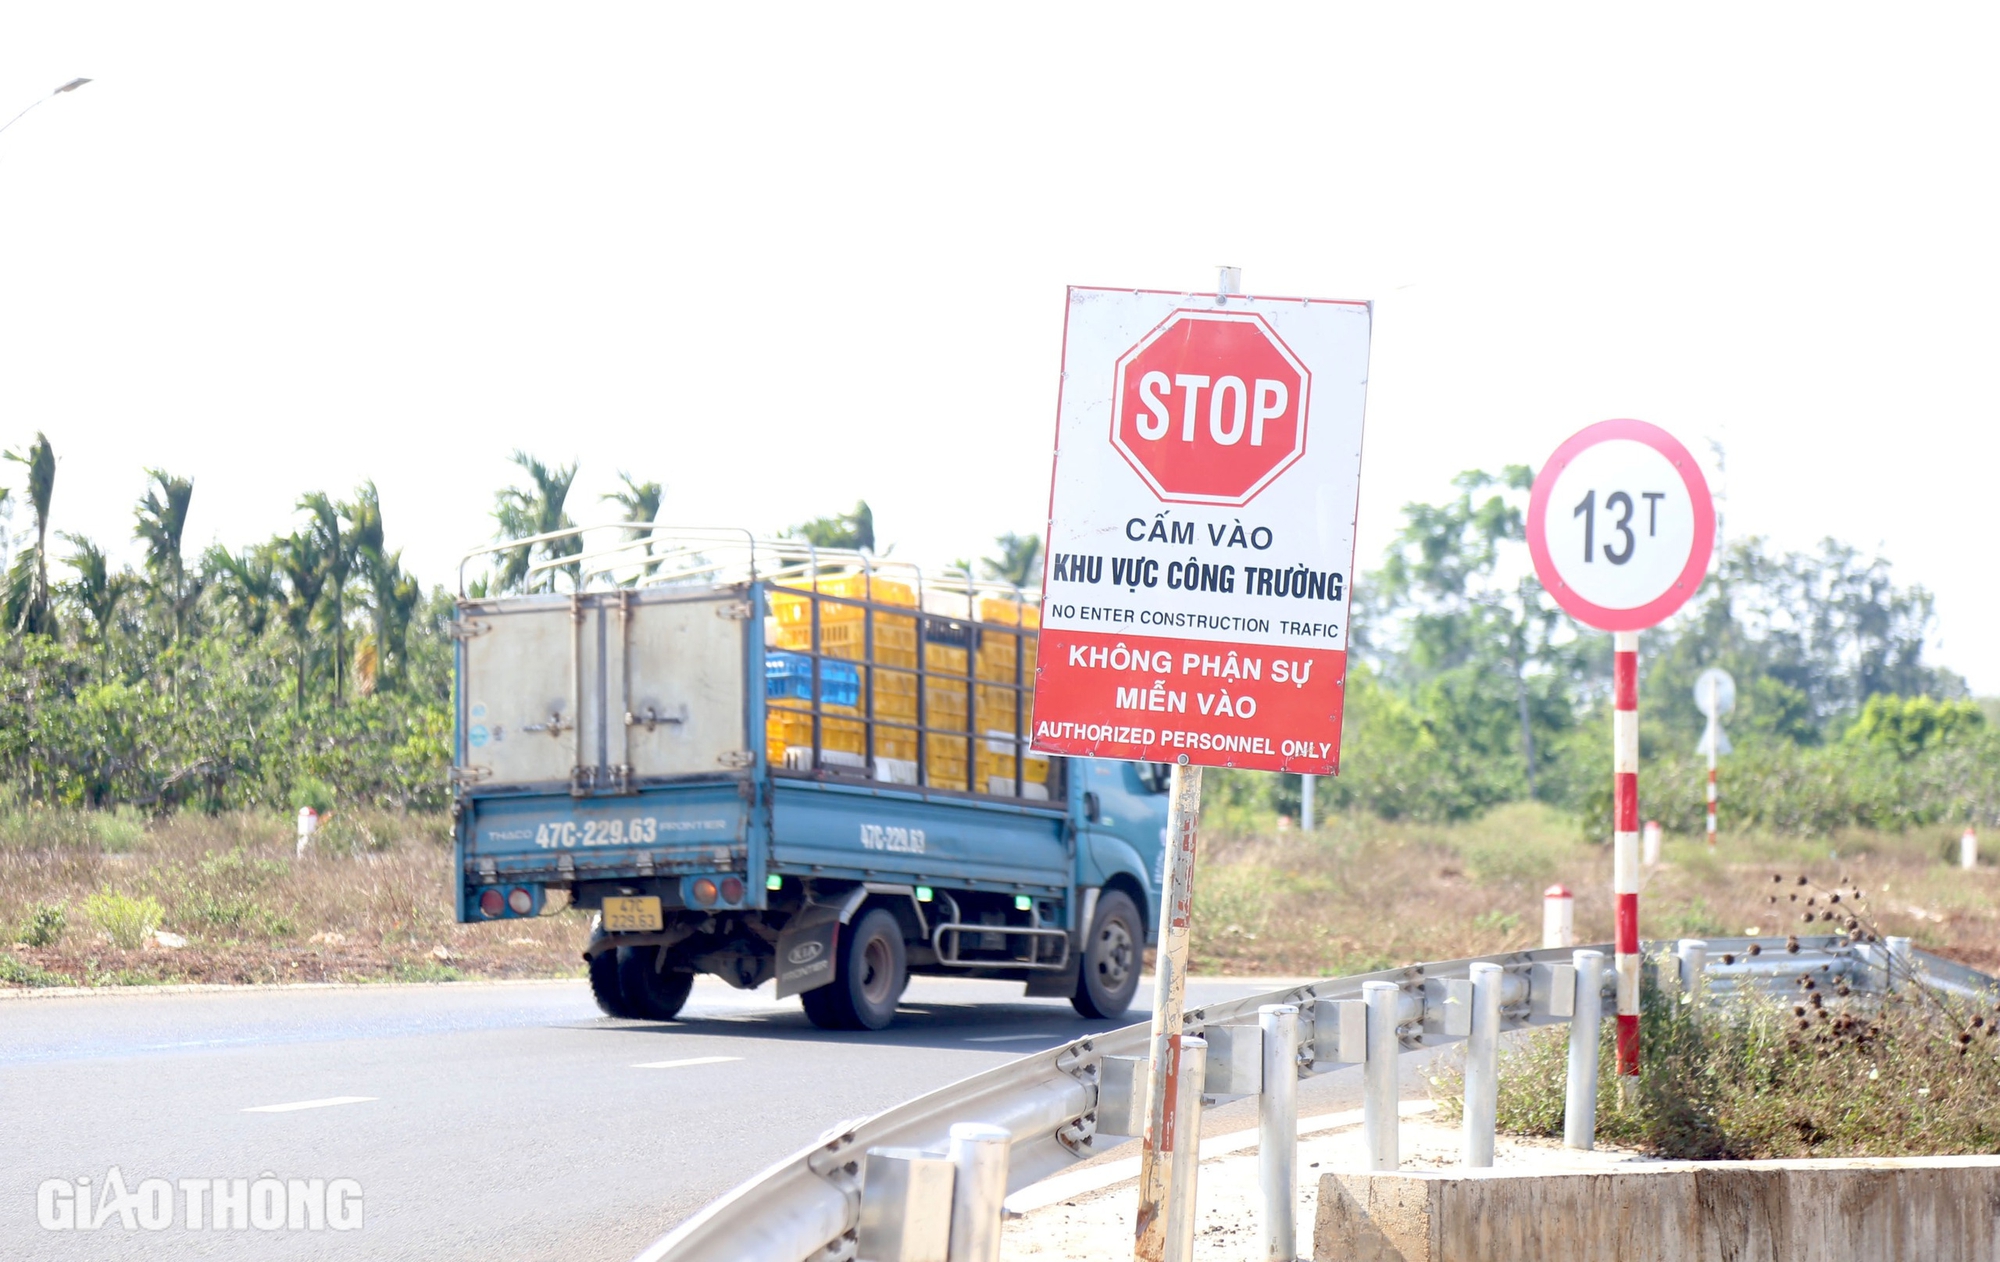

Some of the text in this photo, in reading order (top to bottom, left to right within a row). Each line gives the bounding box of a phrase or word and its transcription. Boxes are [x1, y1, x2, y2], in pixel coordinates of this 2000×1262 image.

[1136, 371, 1289, 447] STOP
[1125, 510, 1274, 551] CẤM VÀO
[1053, 553, 1343, 602] KHU VỰC CÔNG TRƯỜNG
[1052, 604, 1339, 639] NO ENTER CONSTRUCTION TRAFIC
[1068, 642, 1314, 689] KHÔNG PHẬN SỰ
[1115, 679, 1257, 720] MIỄN VÀO
[1037, 721, 1332, 760] AUTHORIZED PERSONNEL ONLY
[535, 817, 657, 849] 47C-229.63
[659, 819, 726, 832] FRONTIER
[619, 898, 645, 913] 47C
